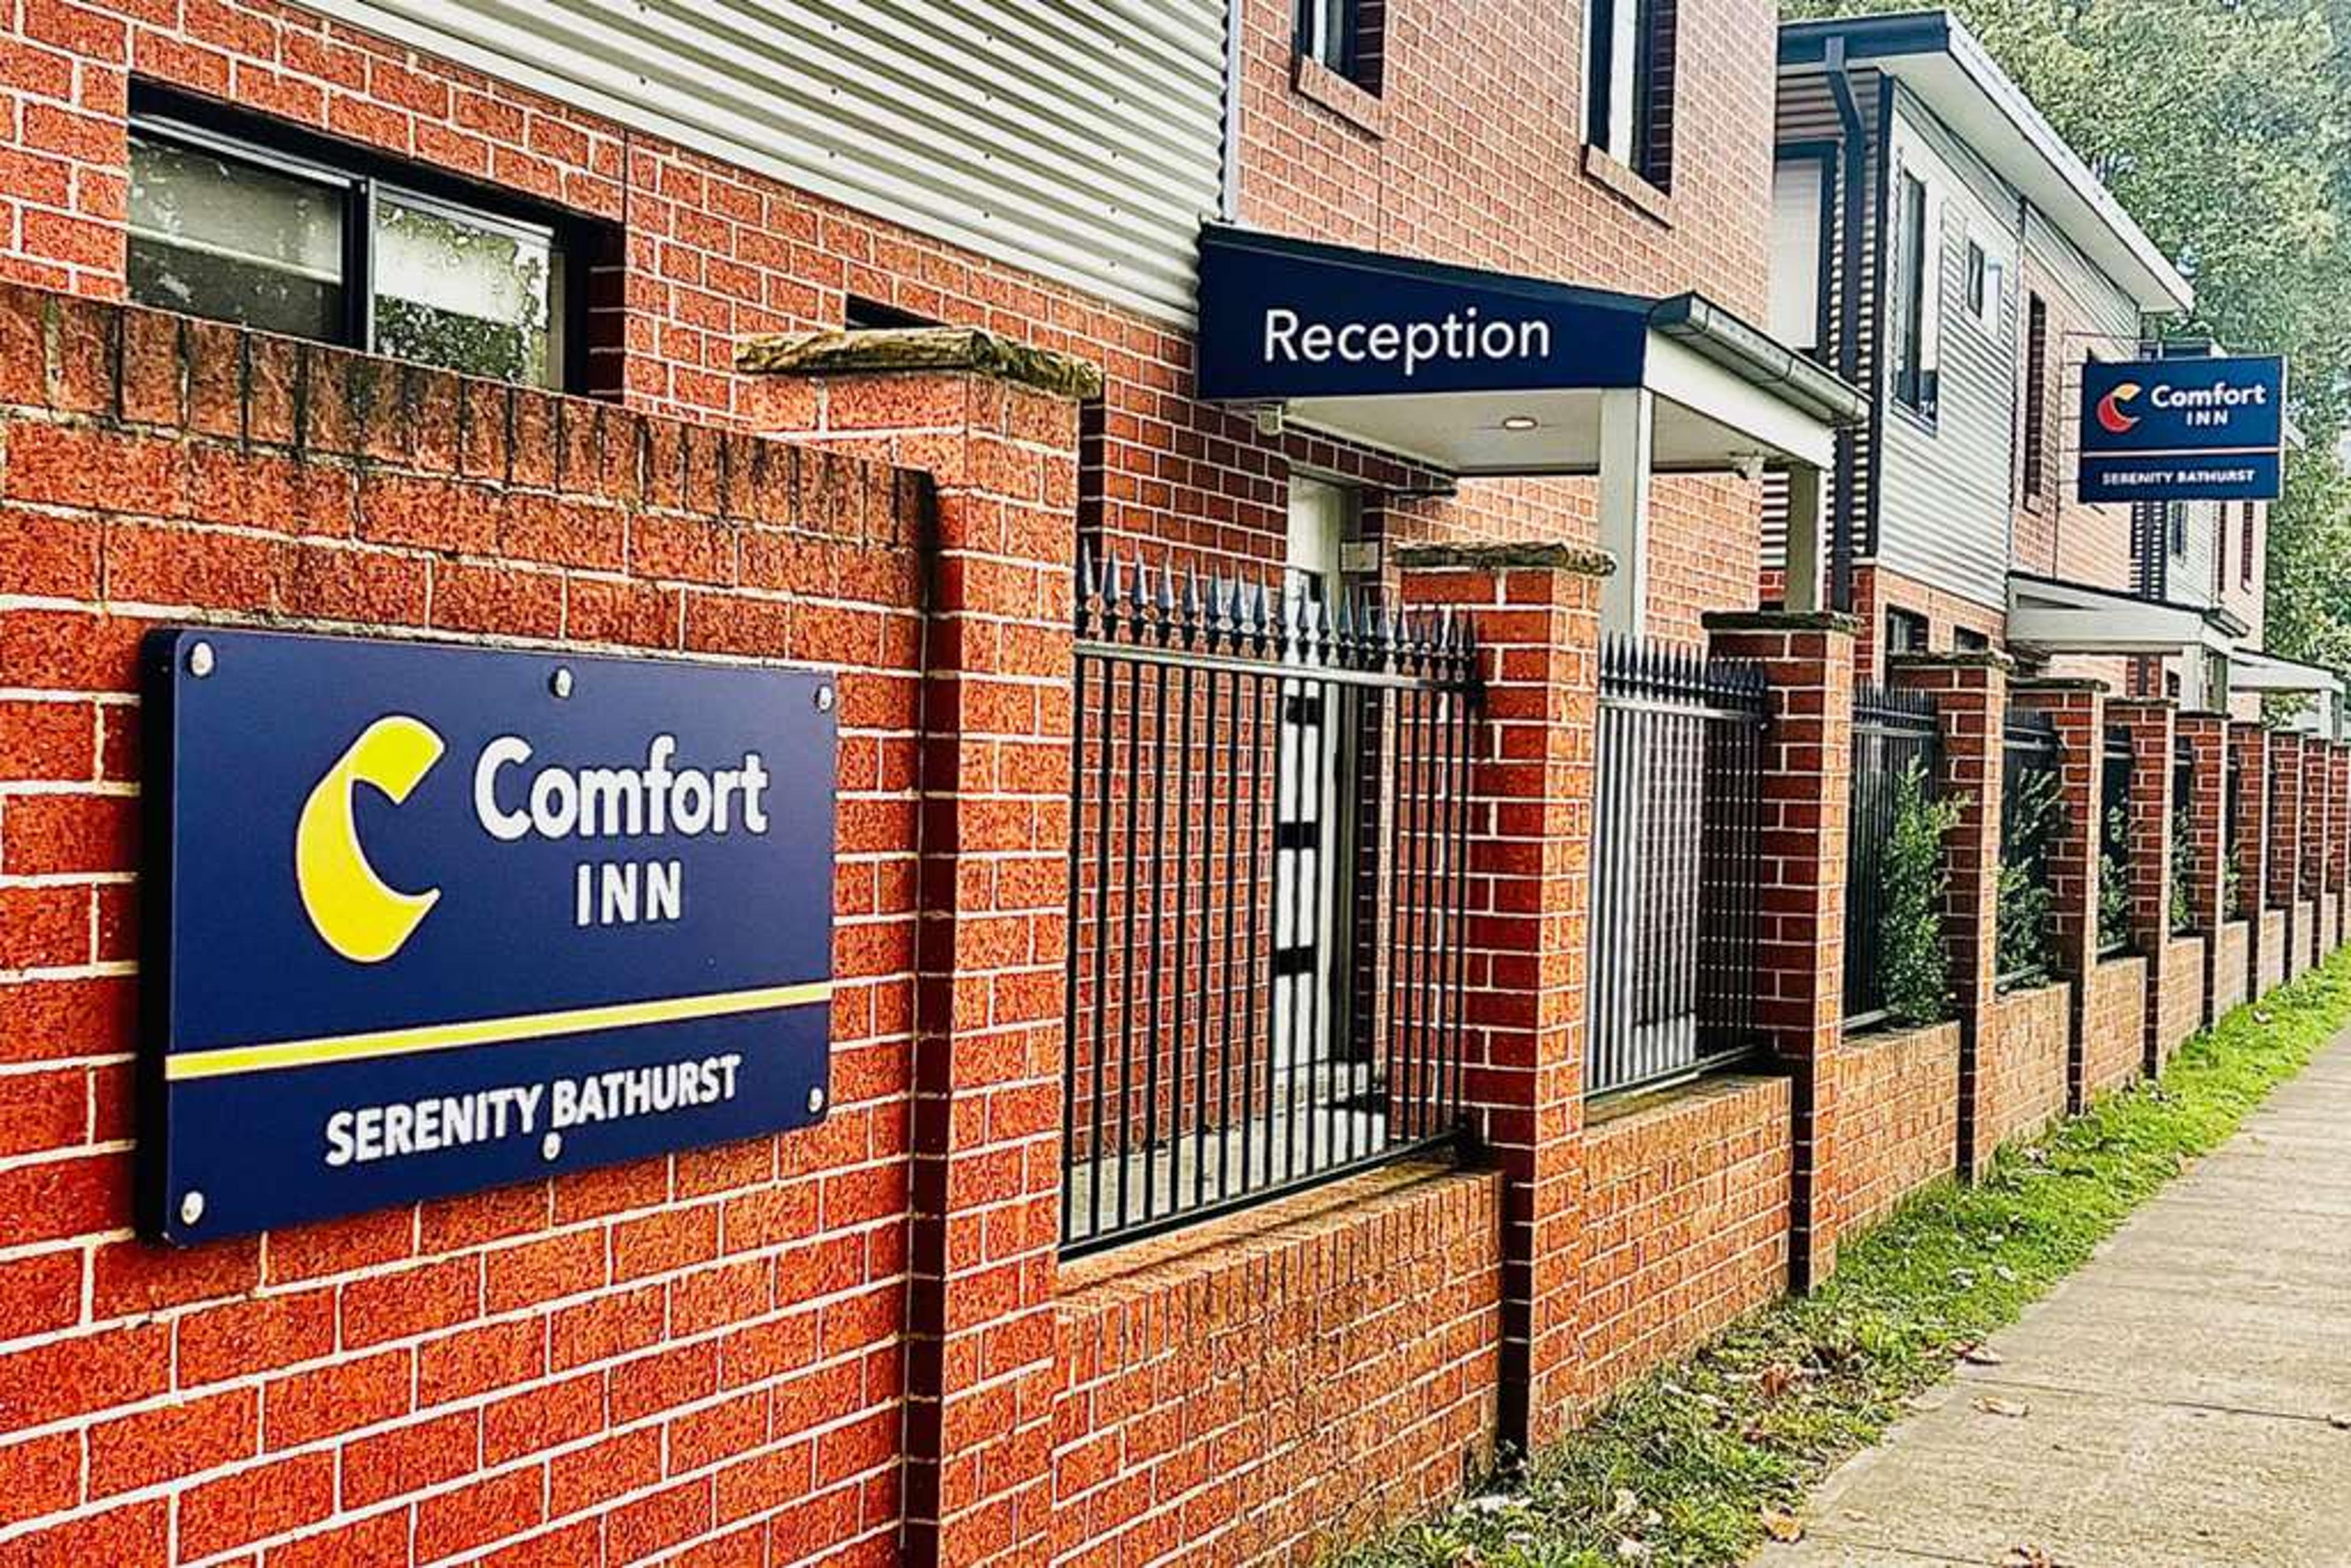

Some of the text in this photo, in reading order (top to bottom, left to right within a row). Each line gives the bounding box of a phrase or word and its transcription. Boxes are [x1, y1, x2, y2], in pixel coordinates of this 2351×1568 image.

[1263, 307, 1551, 378] Reception
[2151, 383, 2266, 407] Comfort
[2186, 410, 2228, 426] INN
[2102, 469, 2255, 486] SERENITY BATHURST
[474, 735, 770, 841] Comfort
[576, 860, 683, 926] INN
[324, 1054, 742, 1167] SERENITY BATHURST
